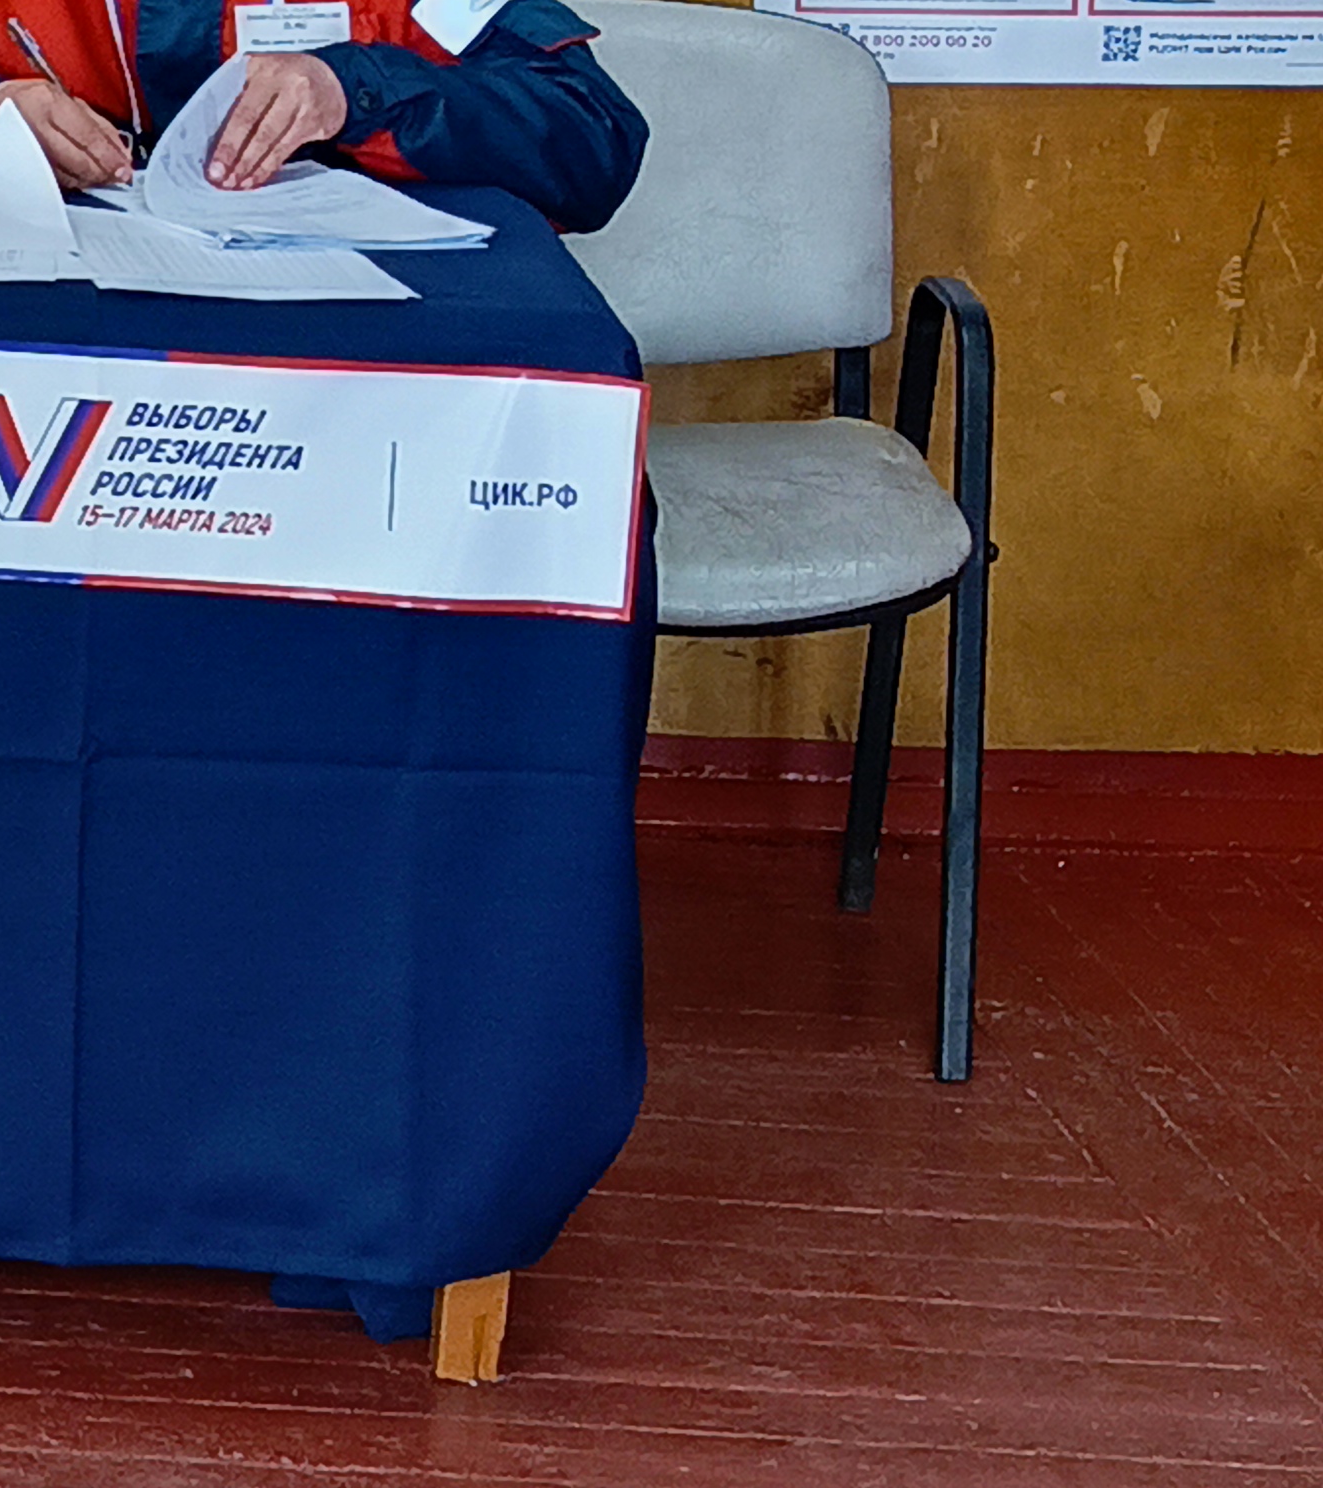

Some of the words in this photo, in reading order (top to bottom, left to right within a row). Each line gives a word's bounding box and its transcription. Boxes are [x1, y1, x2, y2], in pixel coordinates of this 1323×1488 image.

[126, 402, 267, 435] ВЫБОРЫ
[107, 436, 304, 471] ПРЕЗИДЕНТА
[89, 471, 218, 501] РОССИИ
[469, 479, 578, 512] ЦИК.РФ
[139, 506, 216, 533] МАРТА
[217, 511, 272, 536] 2024
